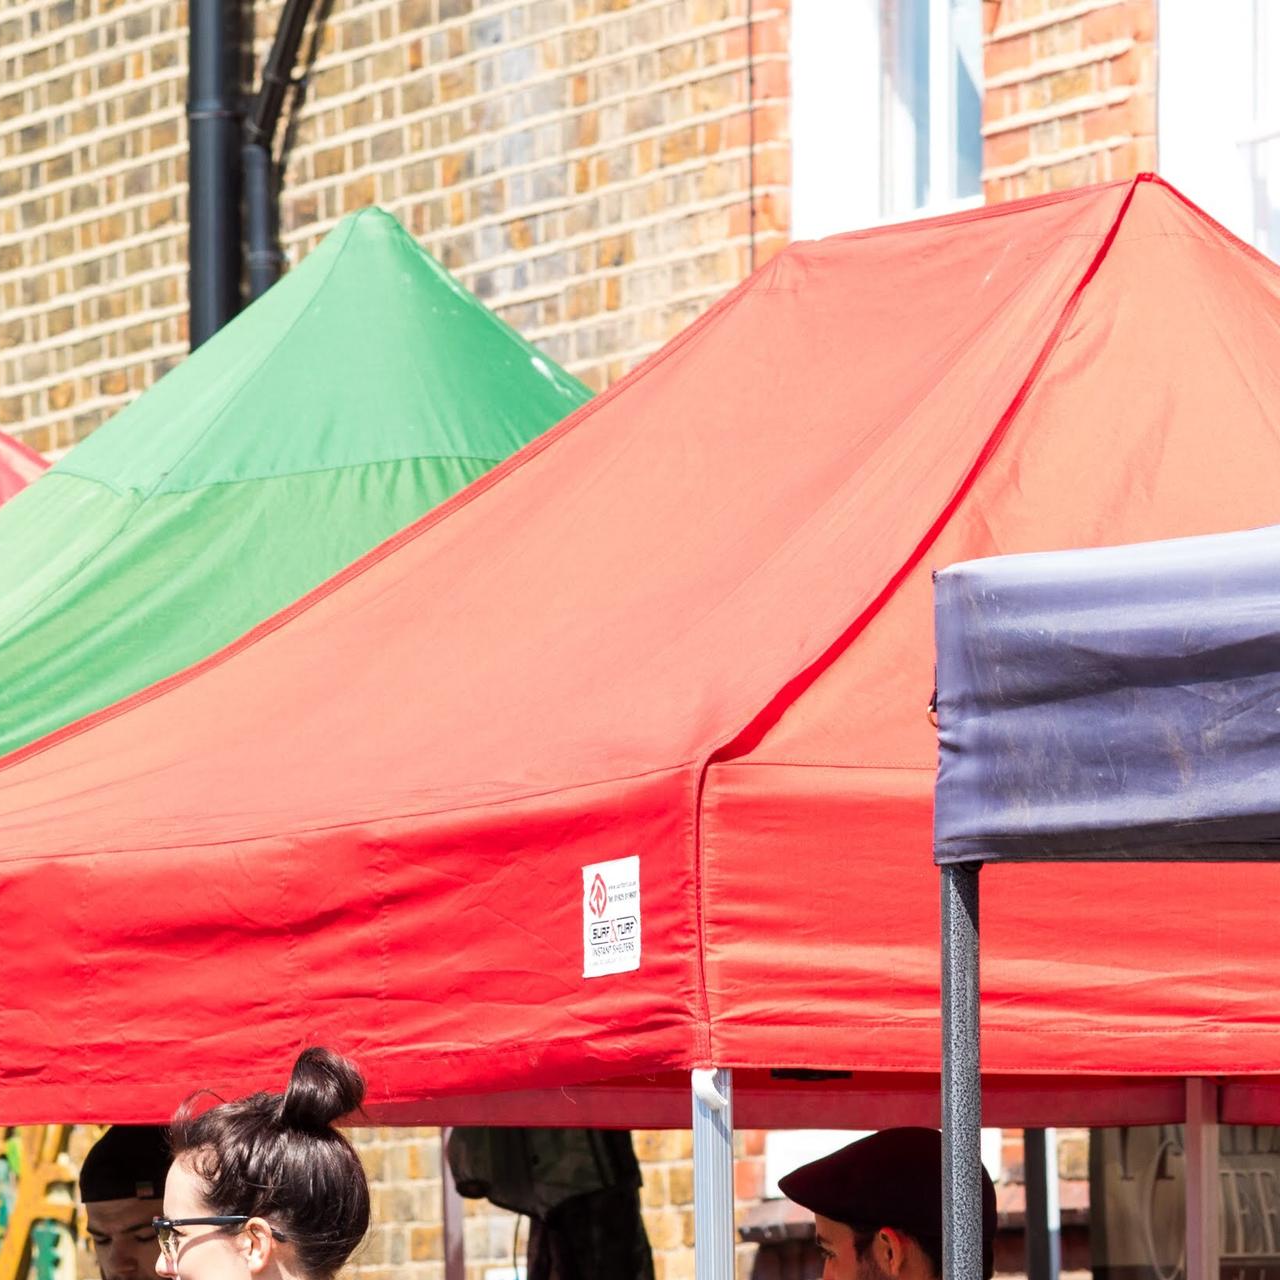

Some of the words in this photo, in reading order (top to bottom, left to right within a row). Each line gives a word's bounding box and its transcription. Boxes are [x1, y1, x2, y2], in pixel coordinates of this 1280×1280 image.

[592, 926, 610, 939] SURF
[617, 922, 634, 935] TURF
[593, 945, 611, 957] INSTANT
[612, 941, 635, 953] SHELTERS
